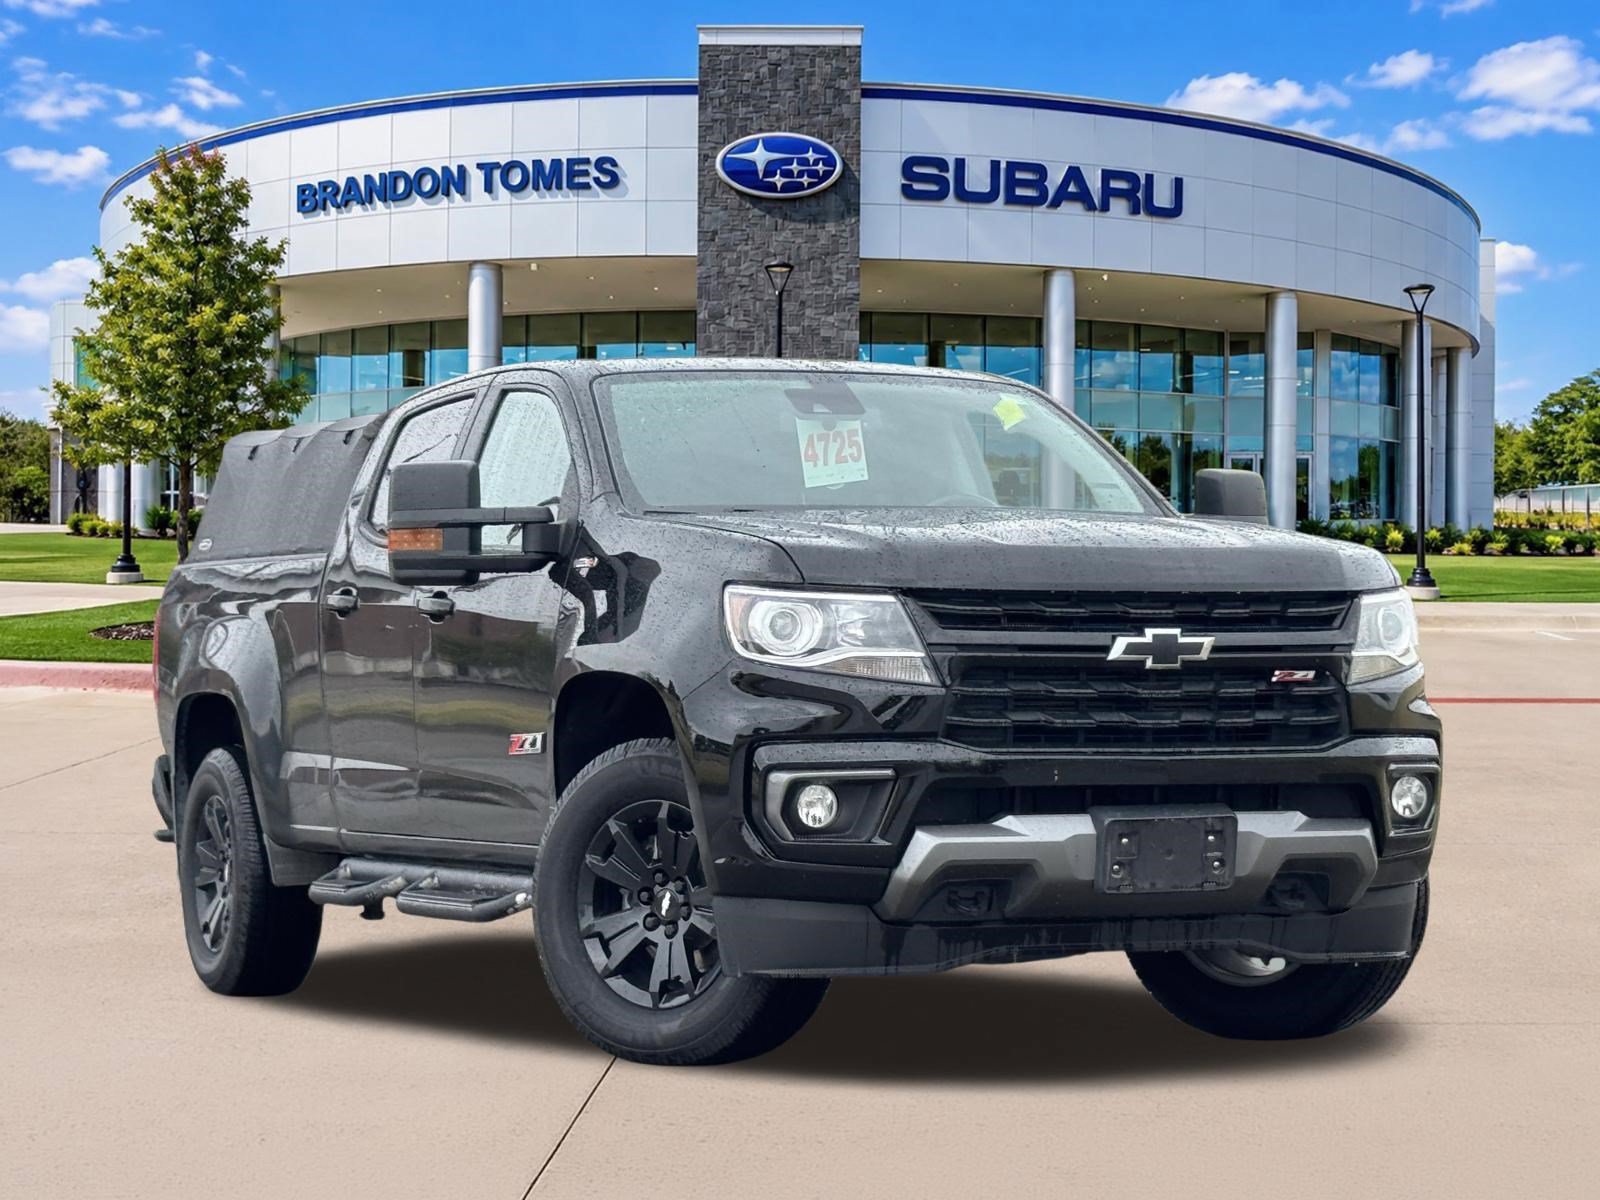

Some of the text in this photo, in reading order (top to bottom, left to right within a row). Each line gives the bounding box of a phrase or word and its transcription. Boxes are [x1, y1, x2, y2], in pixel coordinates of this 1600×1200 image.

[296, 156, 620, 214] BRANDON TOMES
[901, 155, 1184, 218] SUBARU
[803, 428, 862, 468] 4725
